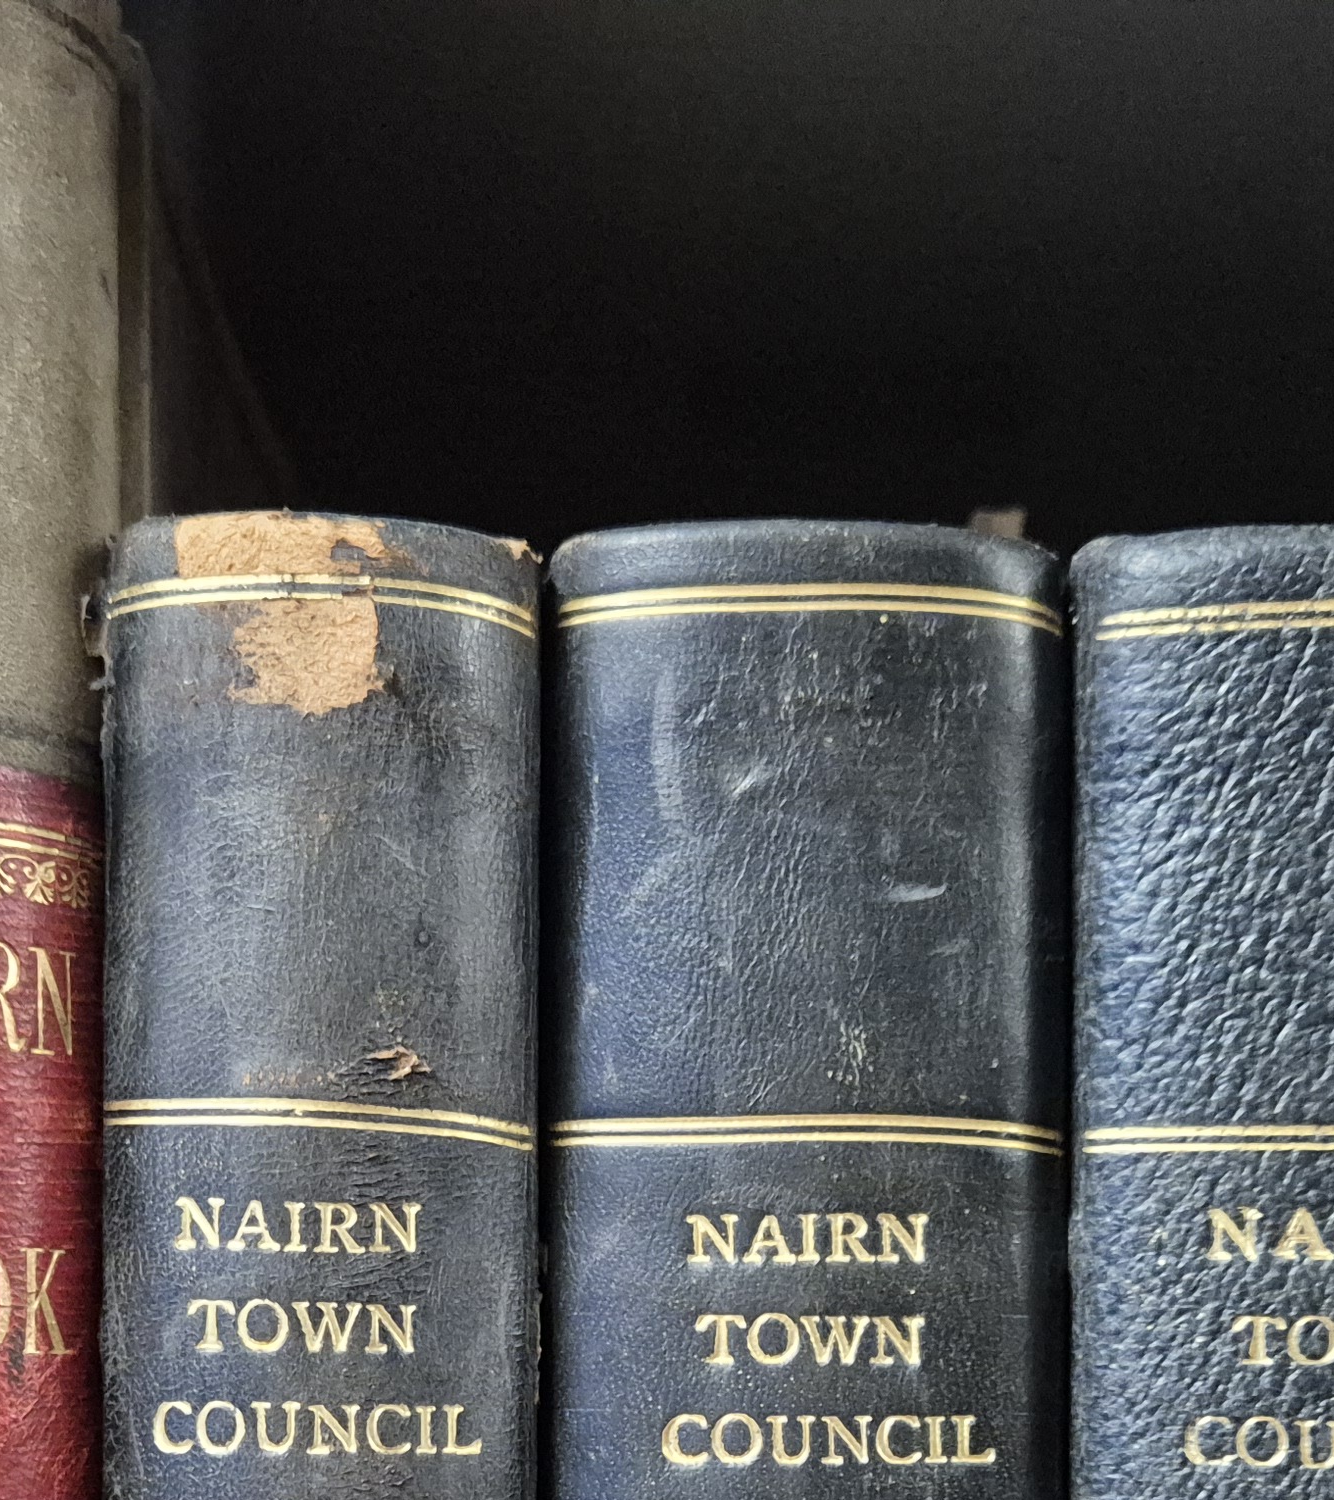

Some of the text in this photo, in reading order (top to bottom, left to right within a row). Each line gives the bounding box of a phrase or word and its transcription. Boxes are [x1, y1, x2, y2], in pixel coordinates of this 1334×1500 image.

[174, 1197, 421, 1253] NAIRN
[686, 1213, 928, 1264] NAIRN
[187, 1299, 417, 1354] TOWN
[695, 1313, 924, 1366] TOWN
[153, 1401, 482, 1456] COUNCIL
[662, 1413, 996, 1465] COUNCIL
